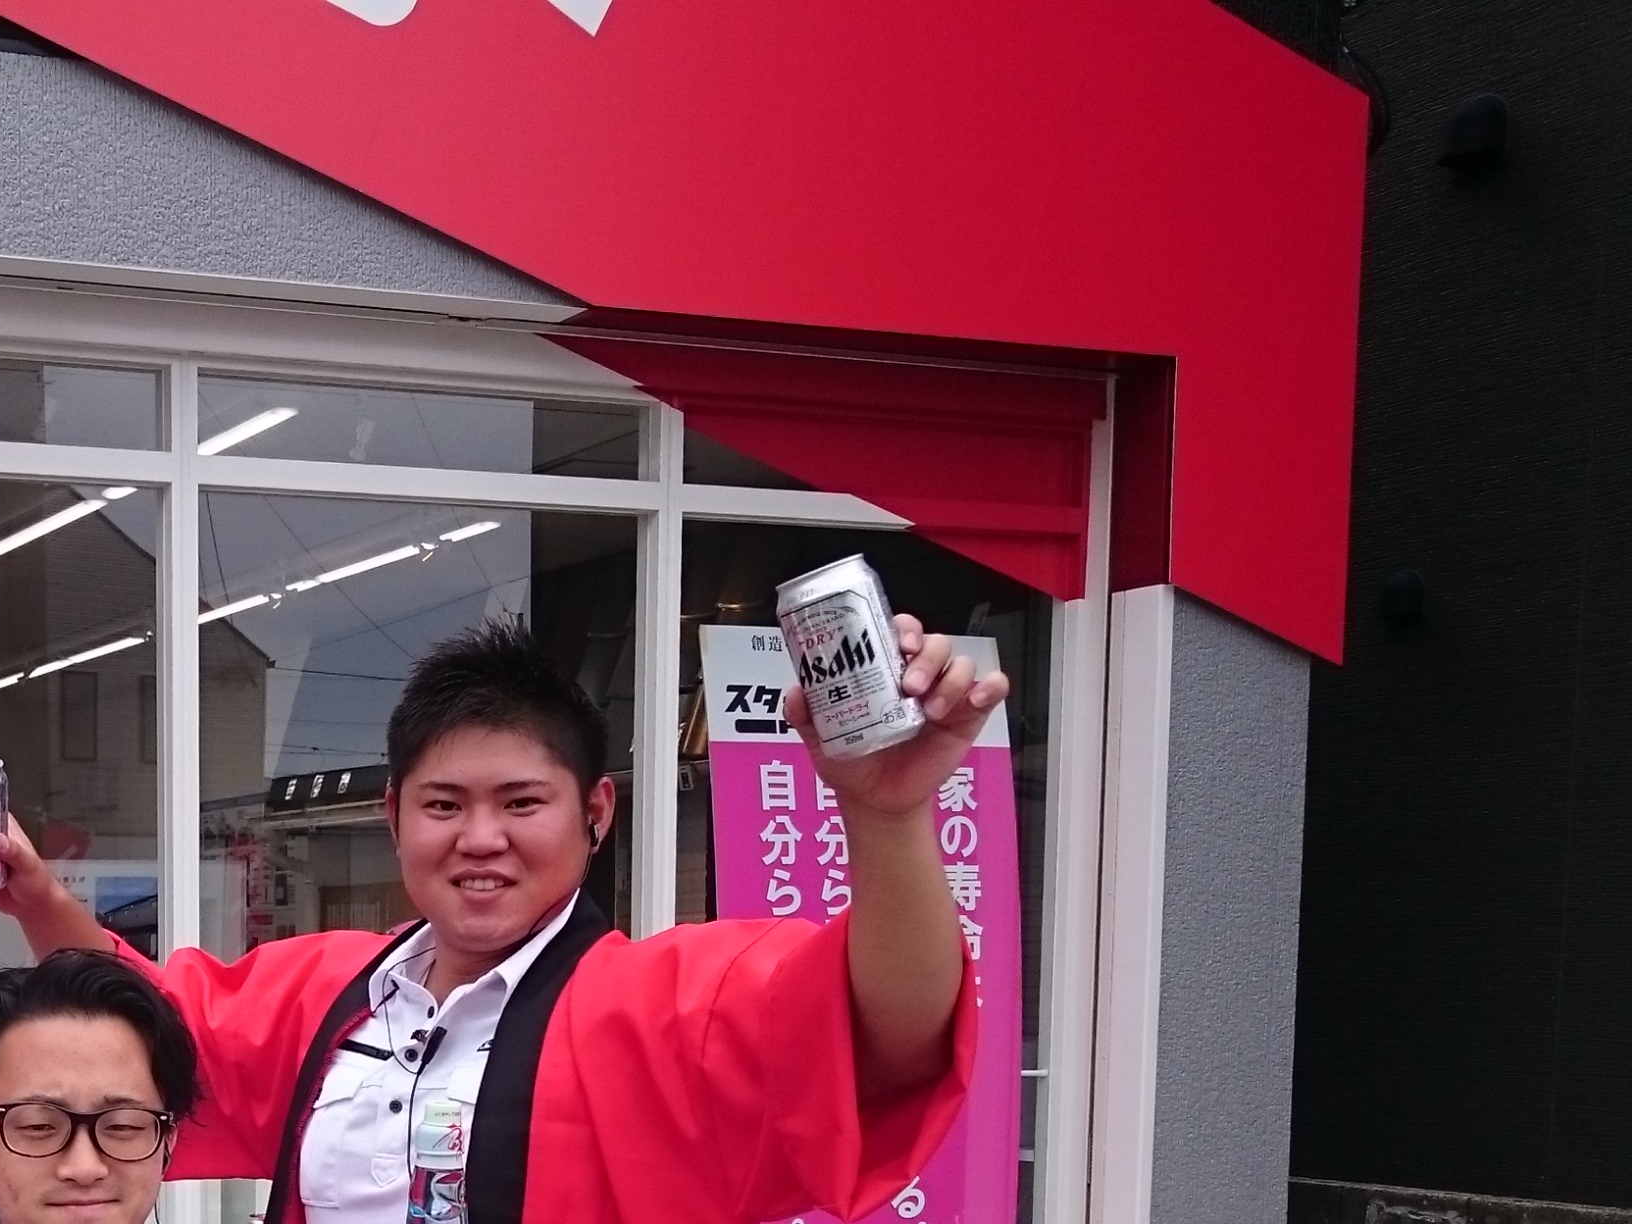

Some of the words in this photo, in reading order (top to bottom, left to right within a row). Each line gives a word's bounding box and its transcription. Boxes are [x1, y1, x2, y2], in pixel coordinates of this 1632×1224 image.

[798, 628, 876, 690] Asahi
[725, 683, 784, 714] スタ
[828, 685, 852, 705] 生
